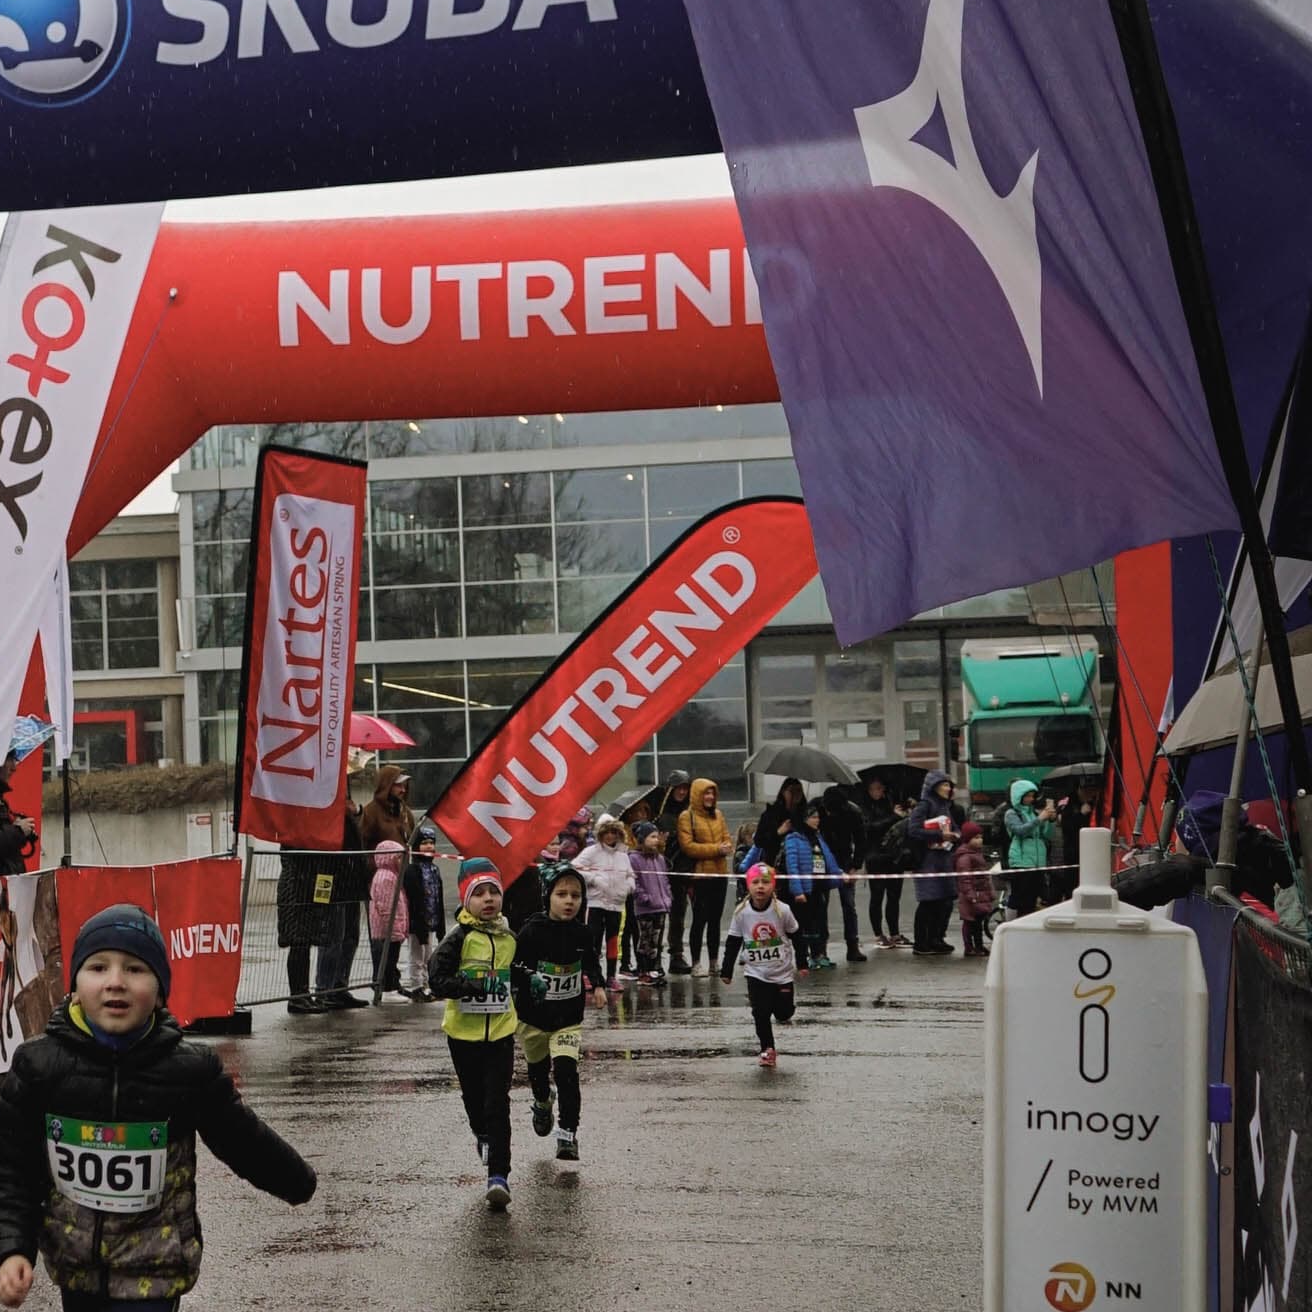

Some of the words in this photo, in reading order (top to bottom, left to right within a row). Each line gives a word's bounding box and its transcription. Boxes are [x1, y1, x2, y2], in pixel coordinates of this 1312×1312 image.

[277, 247, 763, 347] NUTREN
[335, 555, 346, 605] SPRING
[260, 526, 329, 783] Nartes
[331, 607, 344, 669] ARTESIAN
[327, 673, 340, 730] QUALITY
[467, 550, 759, 848] NUTREND
[325, 732, 336, 759] TOP
[748, 947, 781, 963] 3144
[542, 974, 578, 993] 3141
[1027, 1101, 1160, 1141] innogy
[54, 1145, 152, 1192] 3061
[1068, 1169, 1161, 1191] Powered
[1067, 1193, 1091, 1215] by
[1101, 1195, 1158, 1215] MVM
[1106, 1282, 1142, 1300] NN
